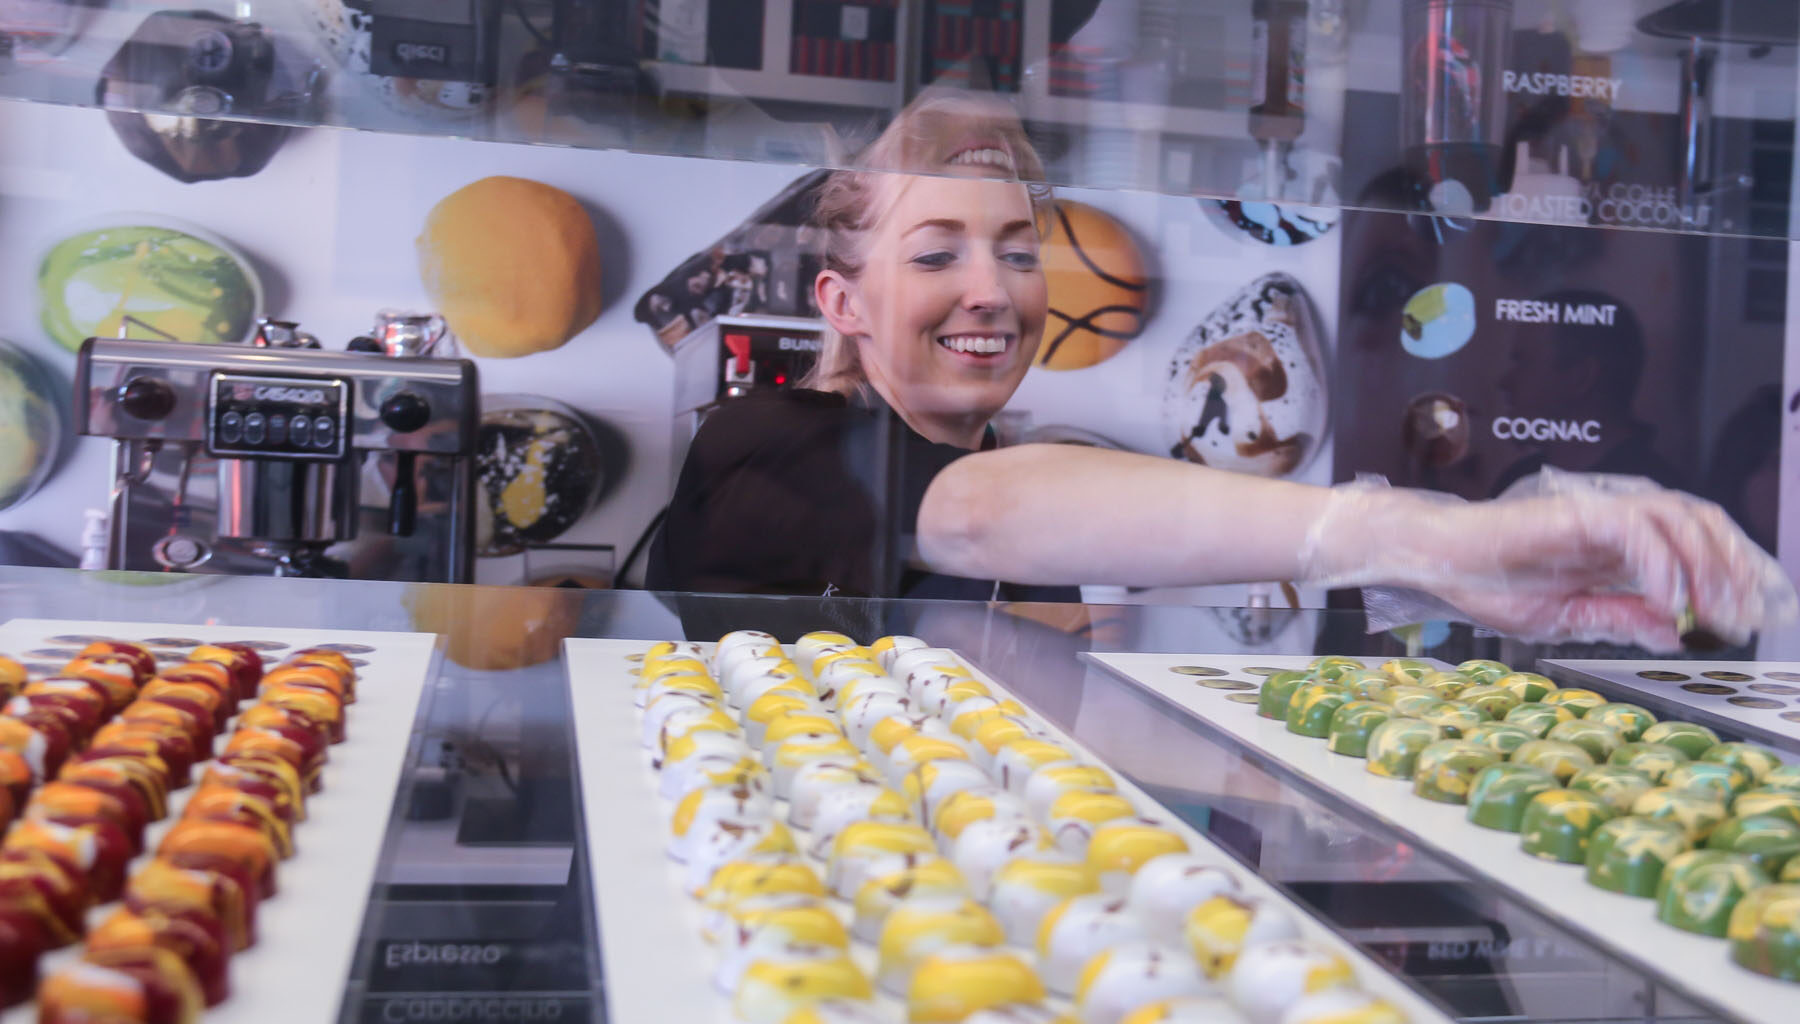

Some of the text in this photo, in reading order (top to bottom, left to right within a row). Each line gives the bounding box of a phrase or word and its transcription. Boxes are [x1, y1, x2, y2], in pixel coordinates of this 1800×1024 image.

[1502, 70, 1623, 100] RASPBERRY
[1500, 193, 1711, 226] TOASTED COCONUT
[1495, 299, 1618, 326] FRESH MINT
[1491, 417, 1601, 443] COGNAC
